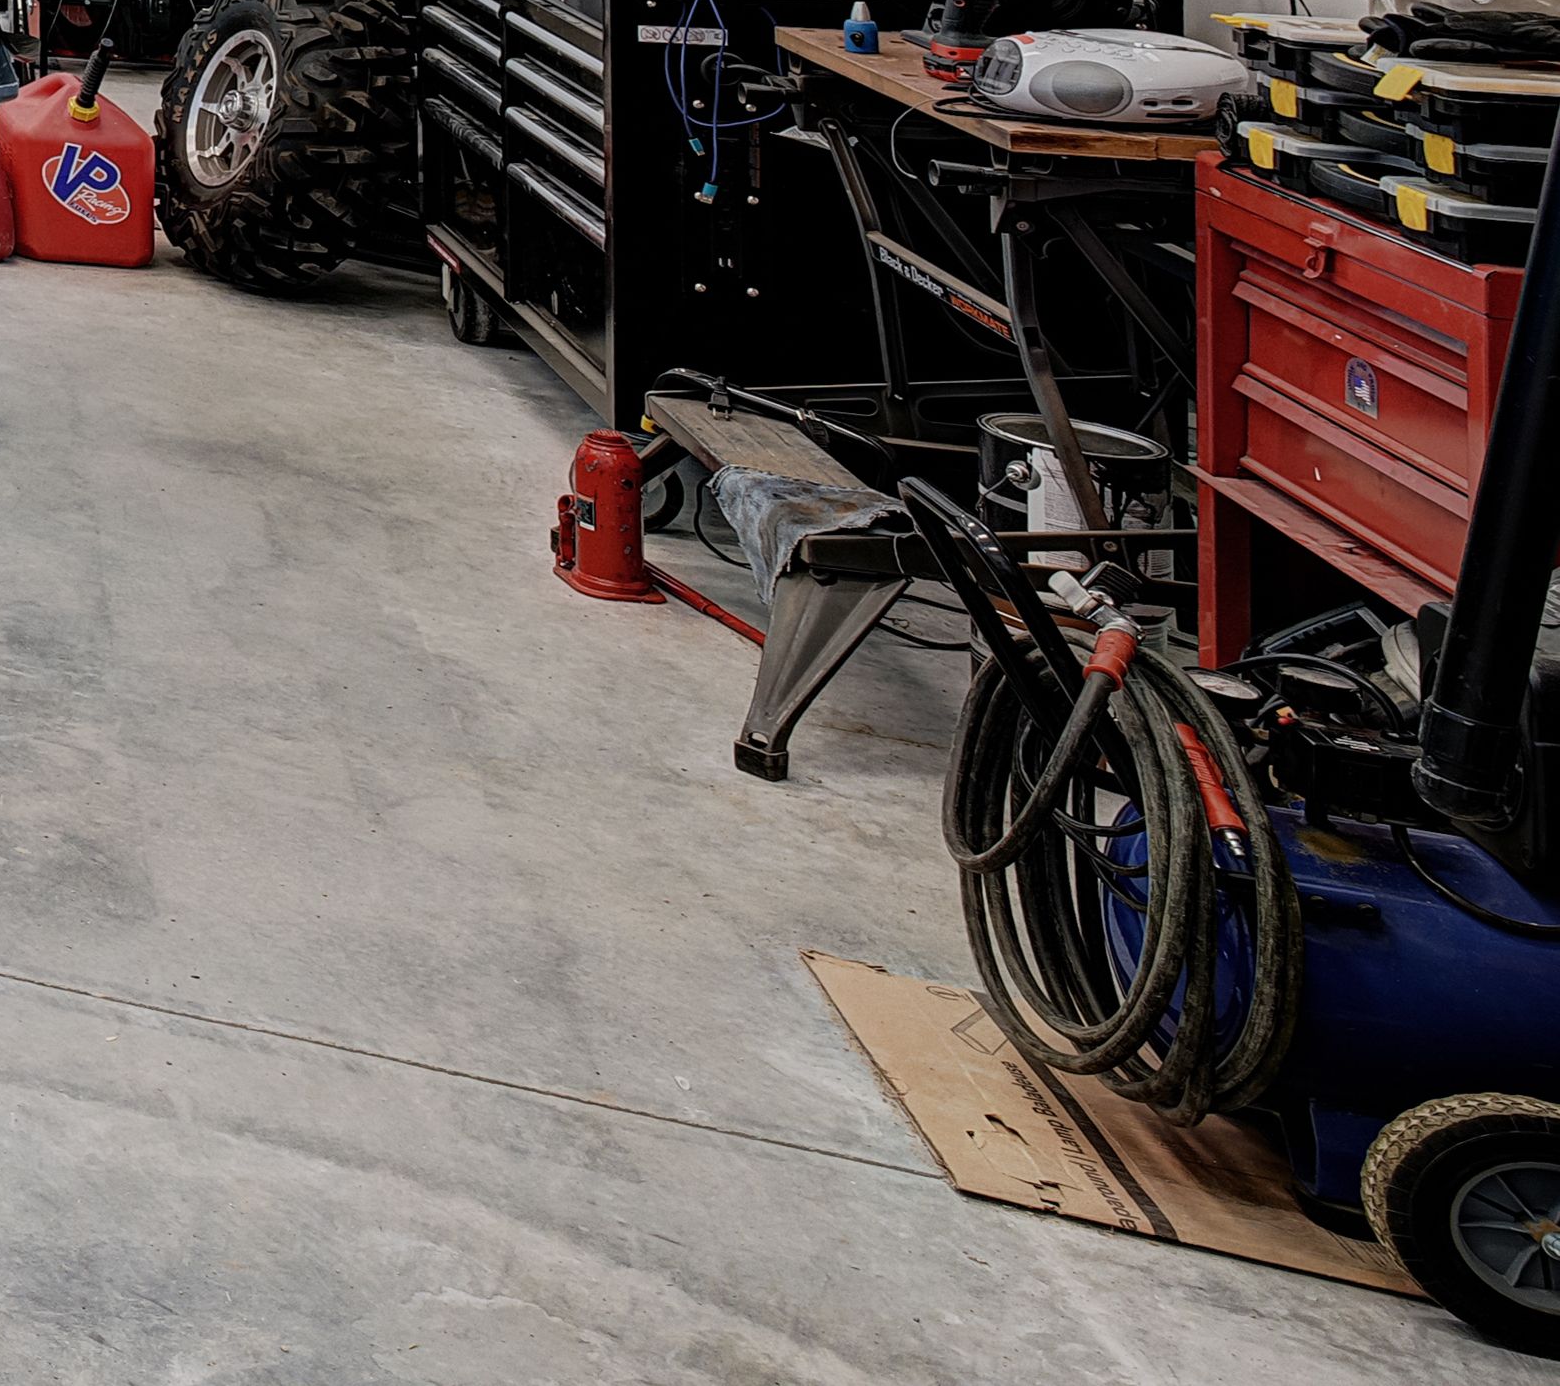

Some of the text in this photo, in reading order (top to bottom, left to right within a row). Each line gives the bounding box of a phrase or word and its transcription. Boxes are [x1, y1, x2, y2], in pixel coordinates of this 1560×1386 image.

[172, 29, 218, 123] MAXXIS
[52, 142, 120, 204] VP
[73, 189, 128, 217] Racing
[1001, 1060, 1057, 1120] Baladeuse
